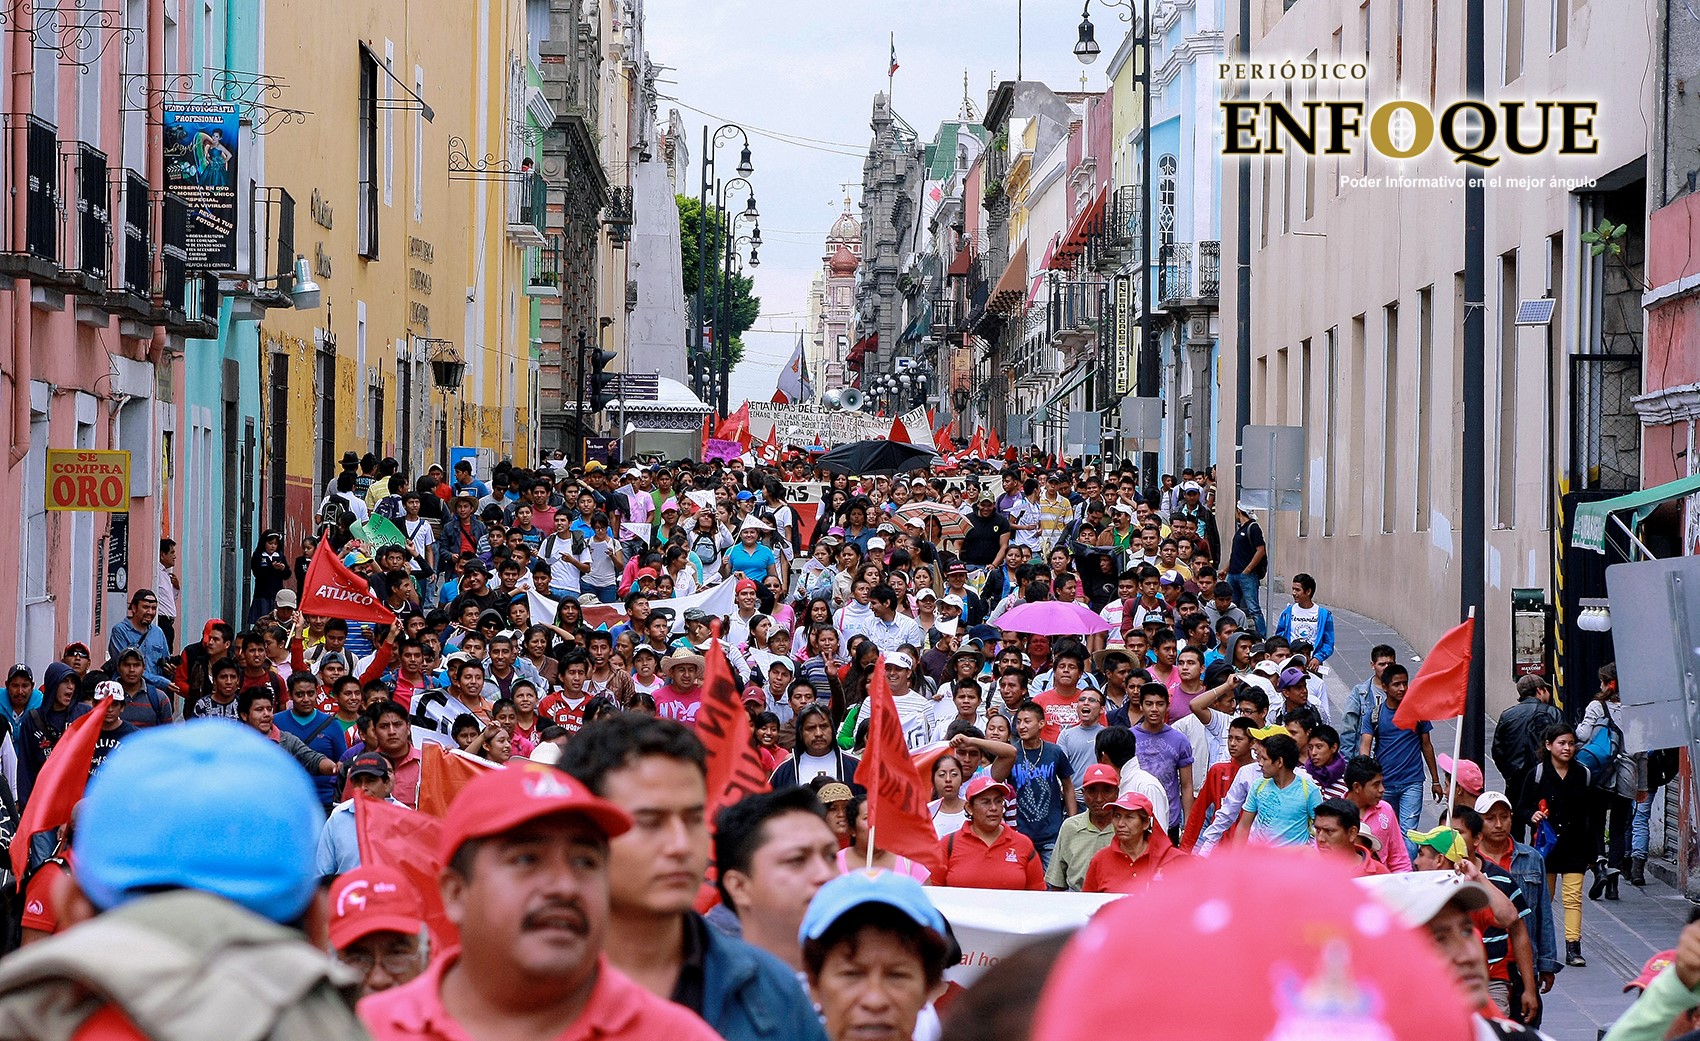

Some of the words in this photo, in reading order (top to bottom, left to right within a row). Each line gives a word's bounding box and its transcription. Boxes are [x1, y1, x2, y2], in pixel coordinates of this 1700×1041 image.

[175, 115, 224, 123] PROFESIONAL
[196, 216, 215, 228] FOTOS
[214, 225, 230, 236] AQUI
[198, 209, 220, 224] REVELA
[222, 220, 234, 229] TUS
[77, 452, 98, 462] SE
[53, 463, 123, 475] COMPRA
[53, 475, 124, 507] ORO
[315, 584, 374, 606] ATLIXCO
